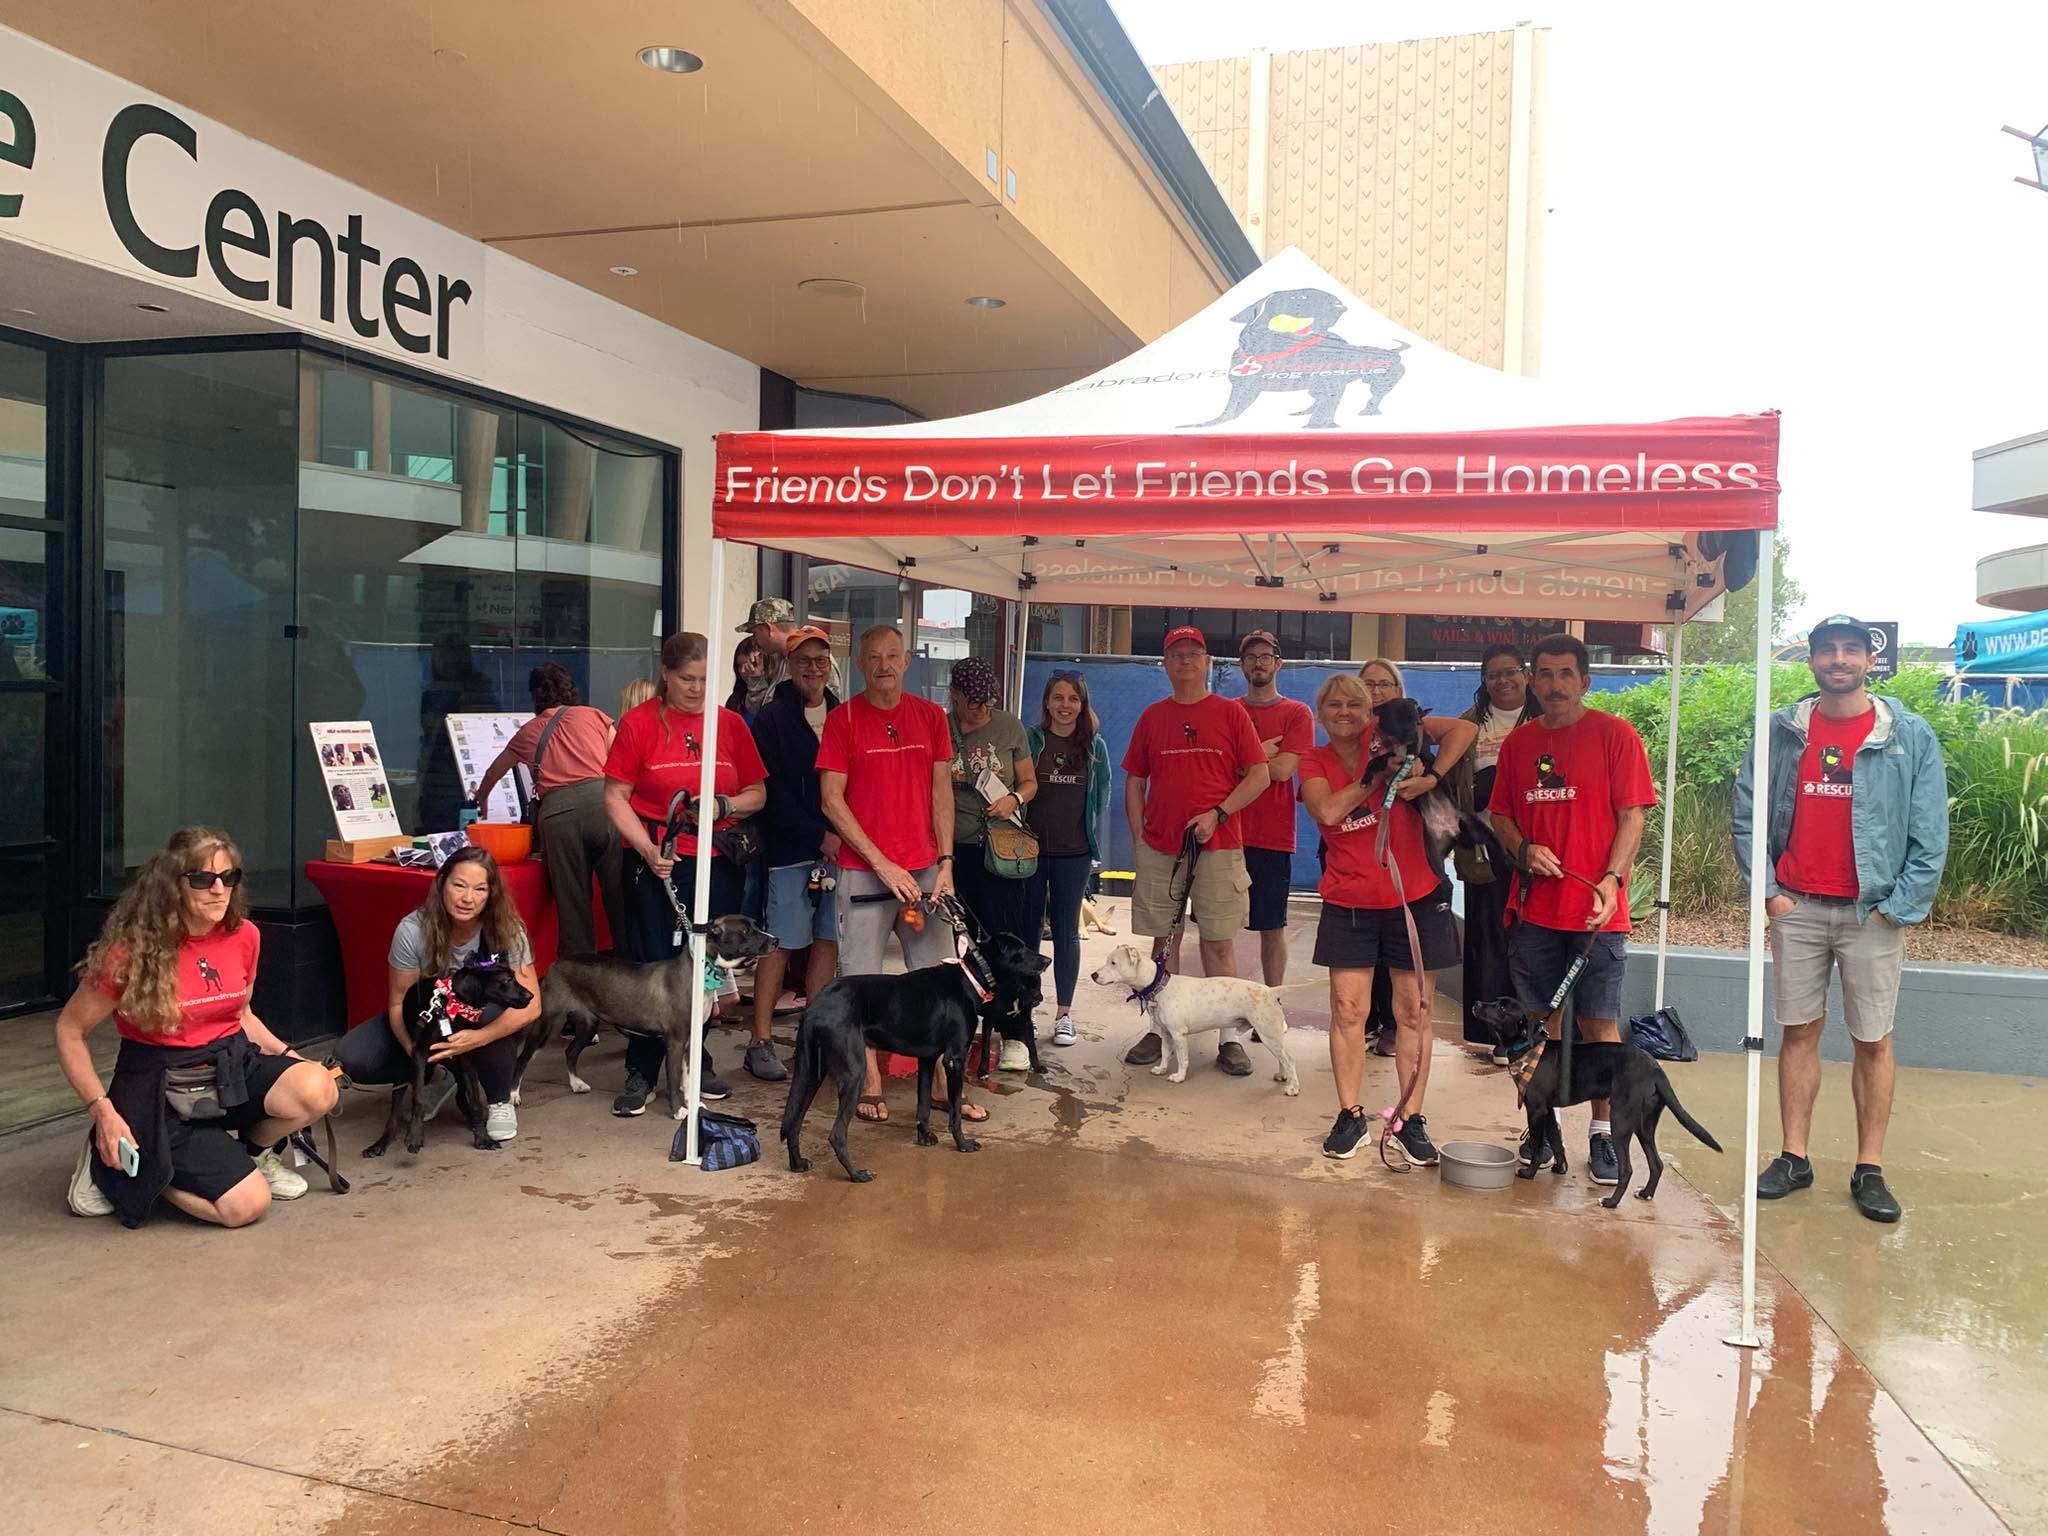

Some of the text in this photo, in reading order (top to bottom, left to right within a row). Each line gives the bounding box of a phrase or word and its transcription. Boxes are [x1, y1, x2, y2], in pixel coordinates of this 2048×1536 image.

[102, 103, 473, 360] Center
[1310, 367, 1389, 379] rescue
[726, 452, 1760, 504] Friends Don't Let Friends Go Homeless
[1049, 774, 1078, 784] RESCUE
[1533, 788, 1567, 800] RESCUE
[1816, 783, 1853, 796] RESCU
[1341, 814, 1378, 833] RESCUE
[1550, 976, 1571, 1009] ADOPT
